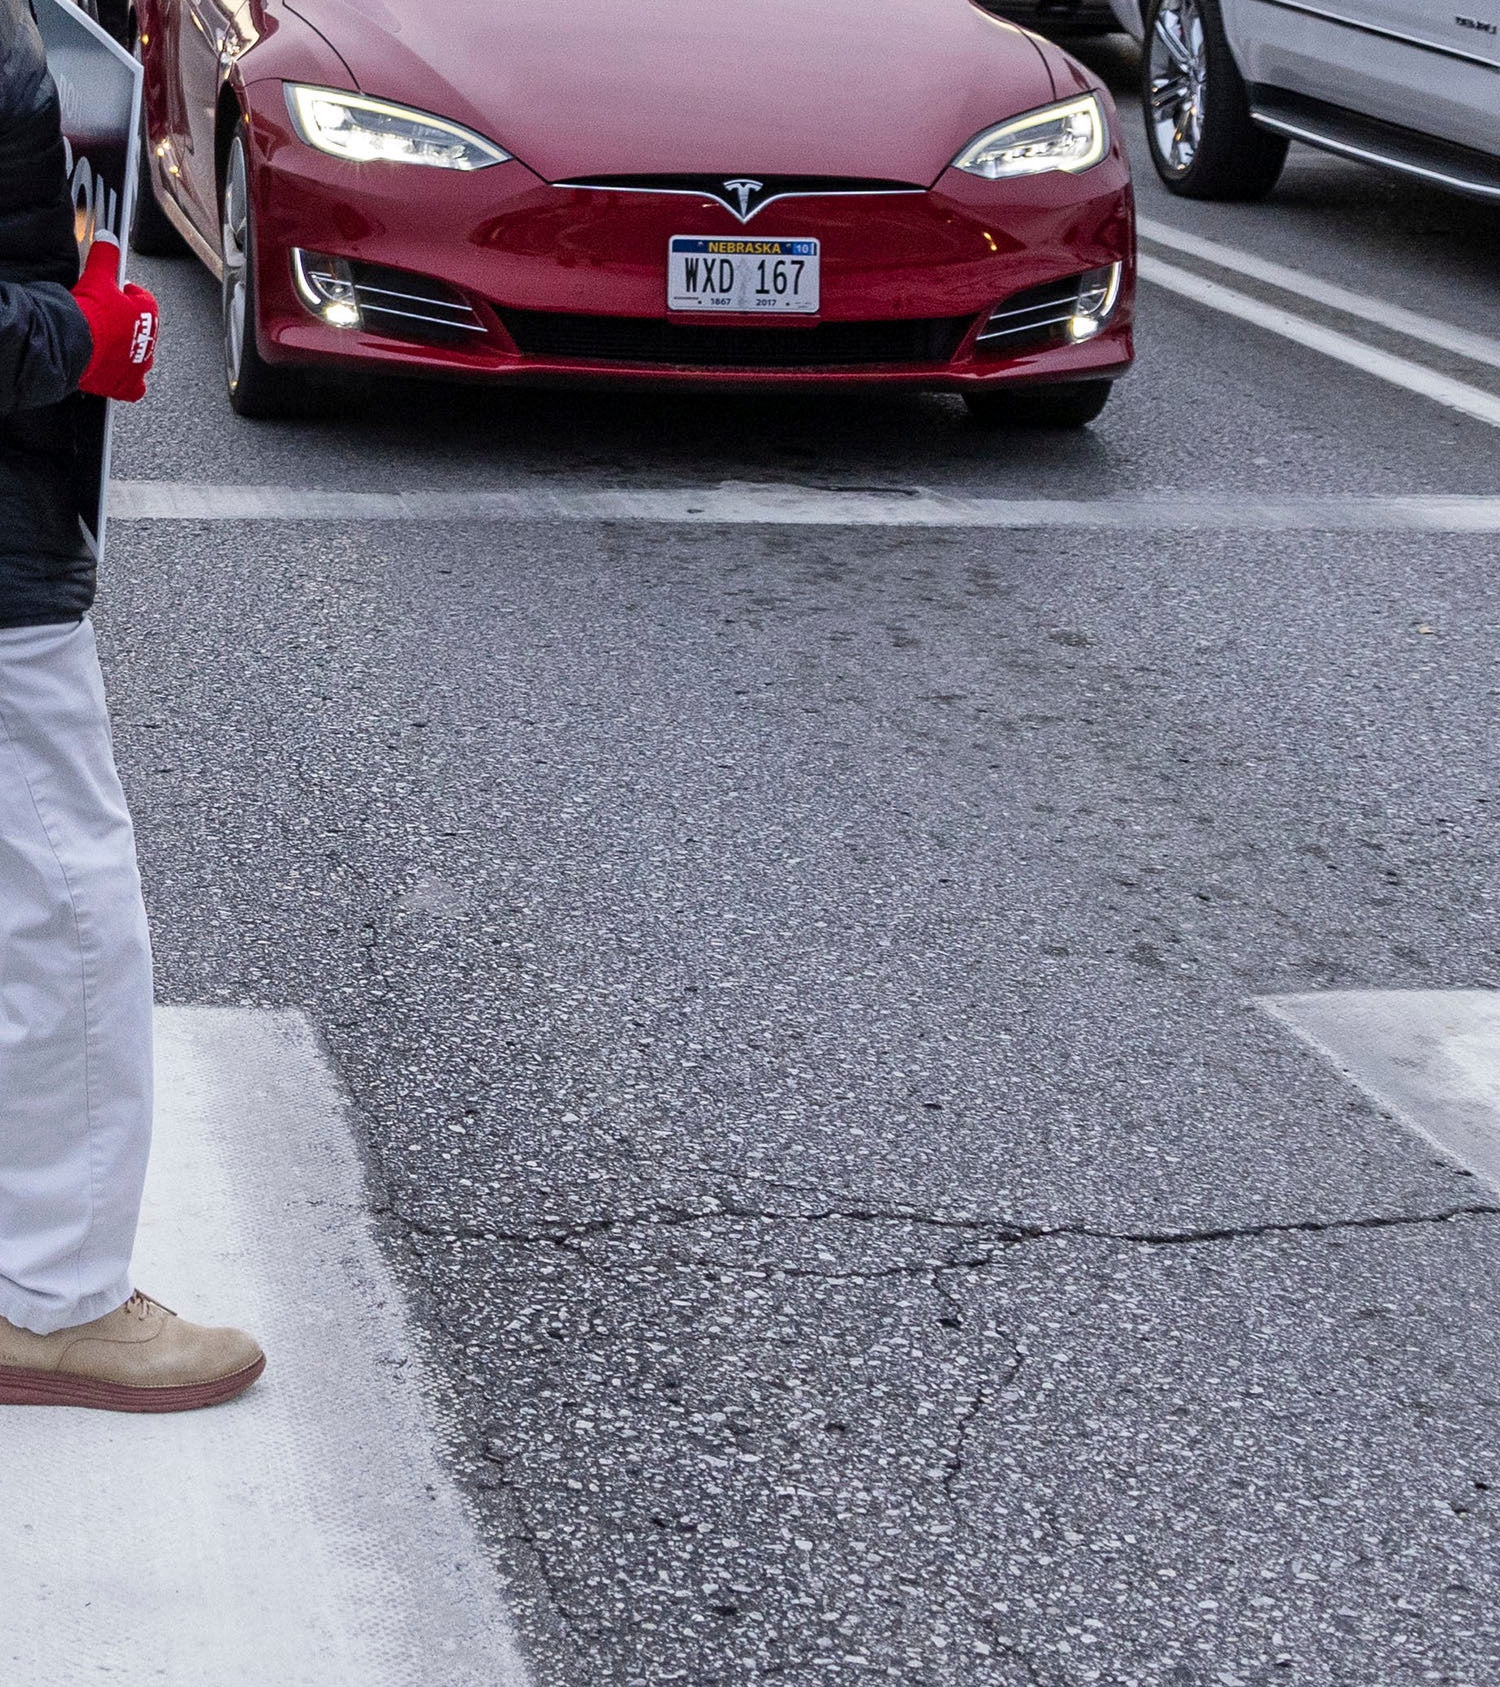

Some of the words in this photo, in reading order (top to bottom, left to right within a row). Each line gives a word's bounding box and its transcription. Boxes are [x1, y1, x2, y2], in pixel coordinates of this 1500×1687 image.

[708, 242, 782, 254] NEBRASKA
[685, 257, 734, 294] WXD
[755, 259, 806, 296] 167
[710, 297, 731, 306] 1867
[756, 298, 777, 307] 2017
